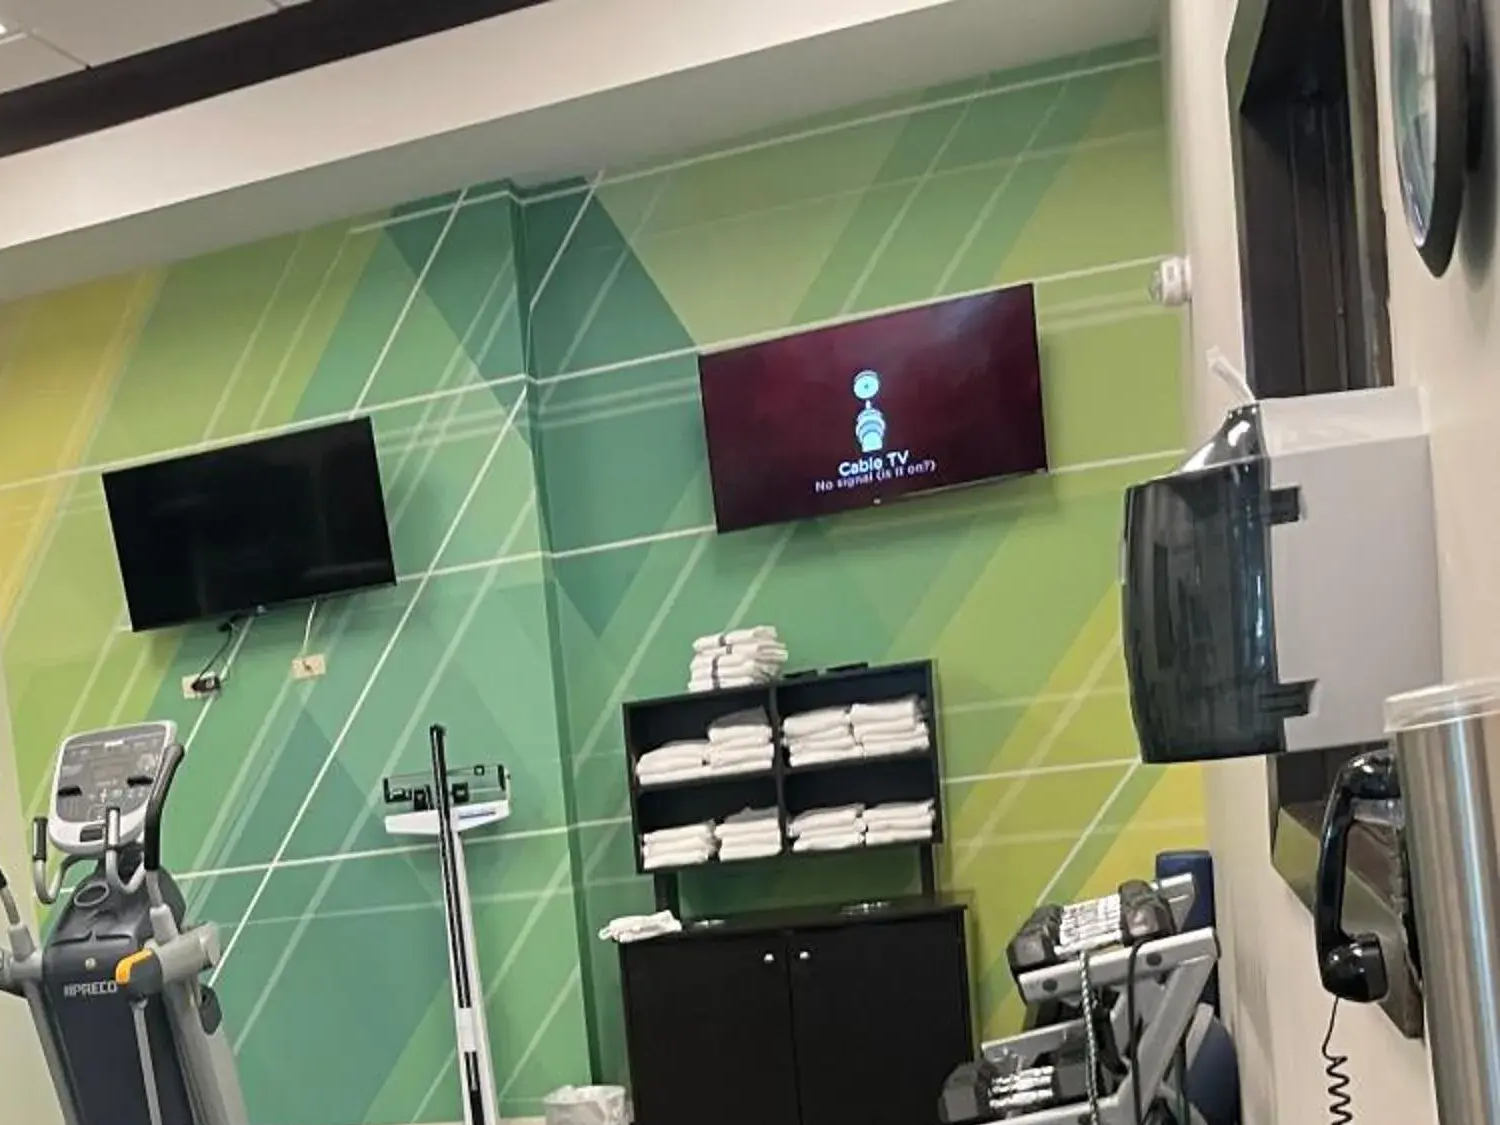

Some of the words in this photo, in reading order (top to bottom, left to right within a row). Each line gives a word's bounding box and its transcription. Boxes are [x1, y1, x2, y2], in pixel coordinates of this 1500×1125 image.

[839, 457, 883, 476] Cable
[886, 449, 910, 467] TV
[815, 480, 834, 492] No
[837, 471, 873, 488] signal
[64, 980, 118, 997] PRECO
